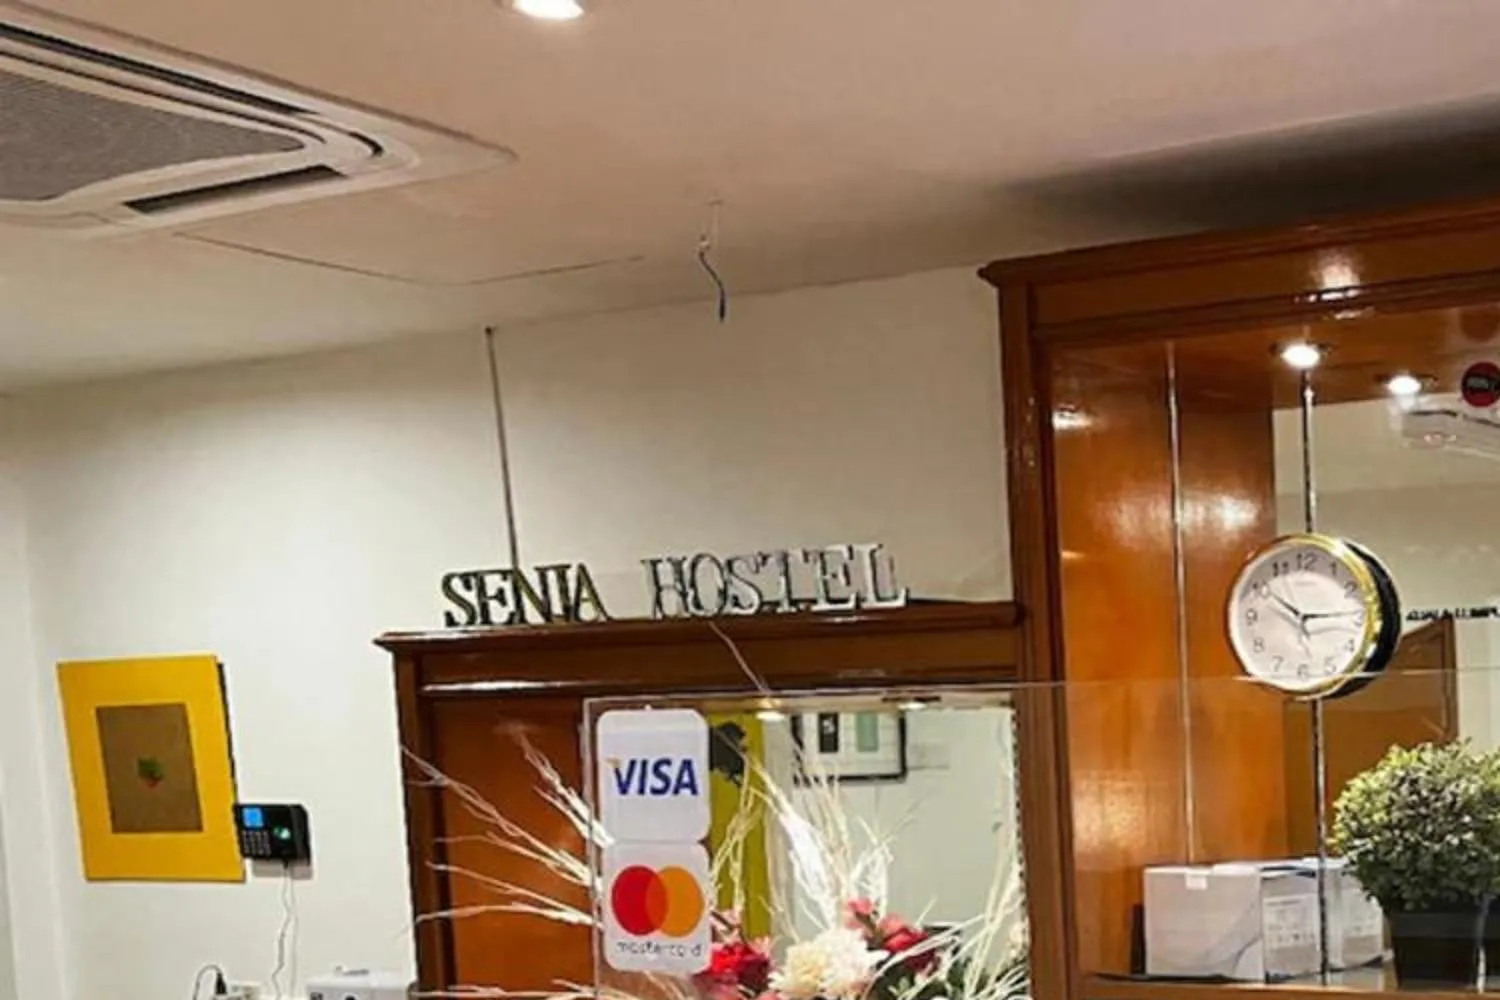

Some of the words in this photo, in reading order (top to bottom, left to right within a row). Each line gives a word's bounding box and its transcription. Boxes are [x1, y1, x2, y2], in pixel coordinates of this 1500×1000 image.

[641, 543, 908, 619] HOSTEL
[1296, 553, 1317, 570] 12
[613, 757, 698, 796] VISA
